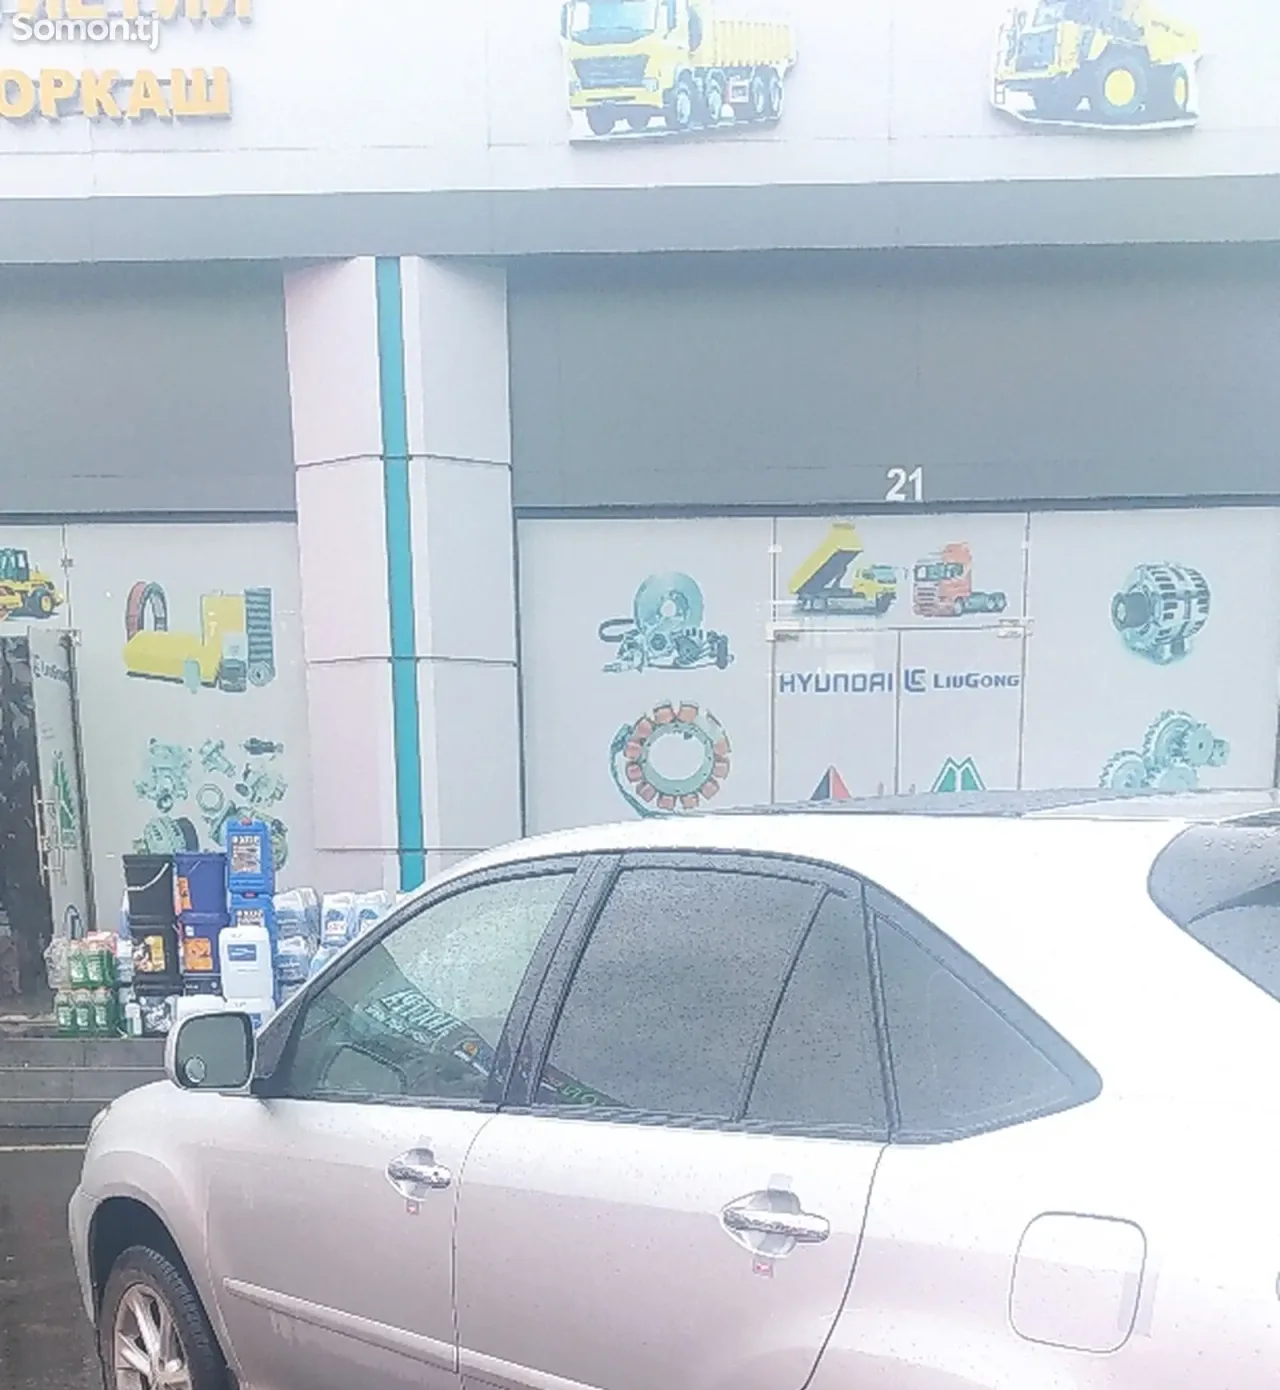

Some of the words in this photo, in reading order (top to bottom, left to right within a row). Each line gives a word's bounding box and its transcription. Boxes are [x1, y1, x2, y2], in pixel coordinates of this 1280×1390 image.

[0, 67, 233, 118] ОРКАШ
[886, 467, 922, 501] 21
[779, 672, 893, 693] HYUNDAI
